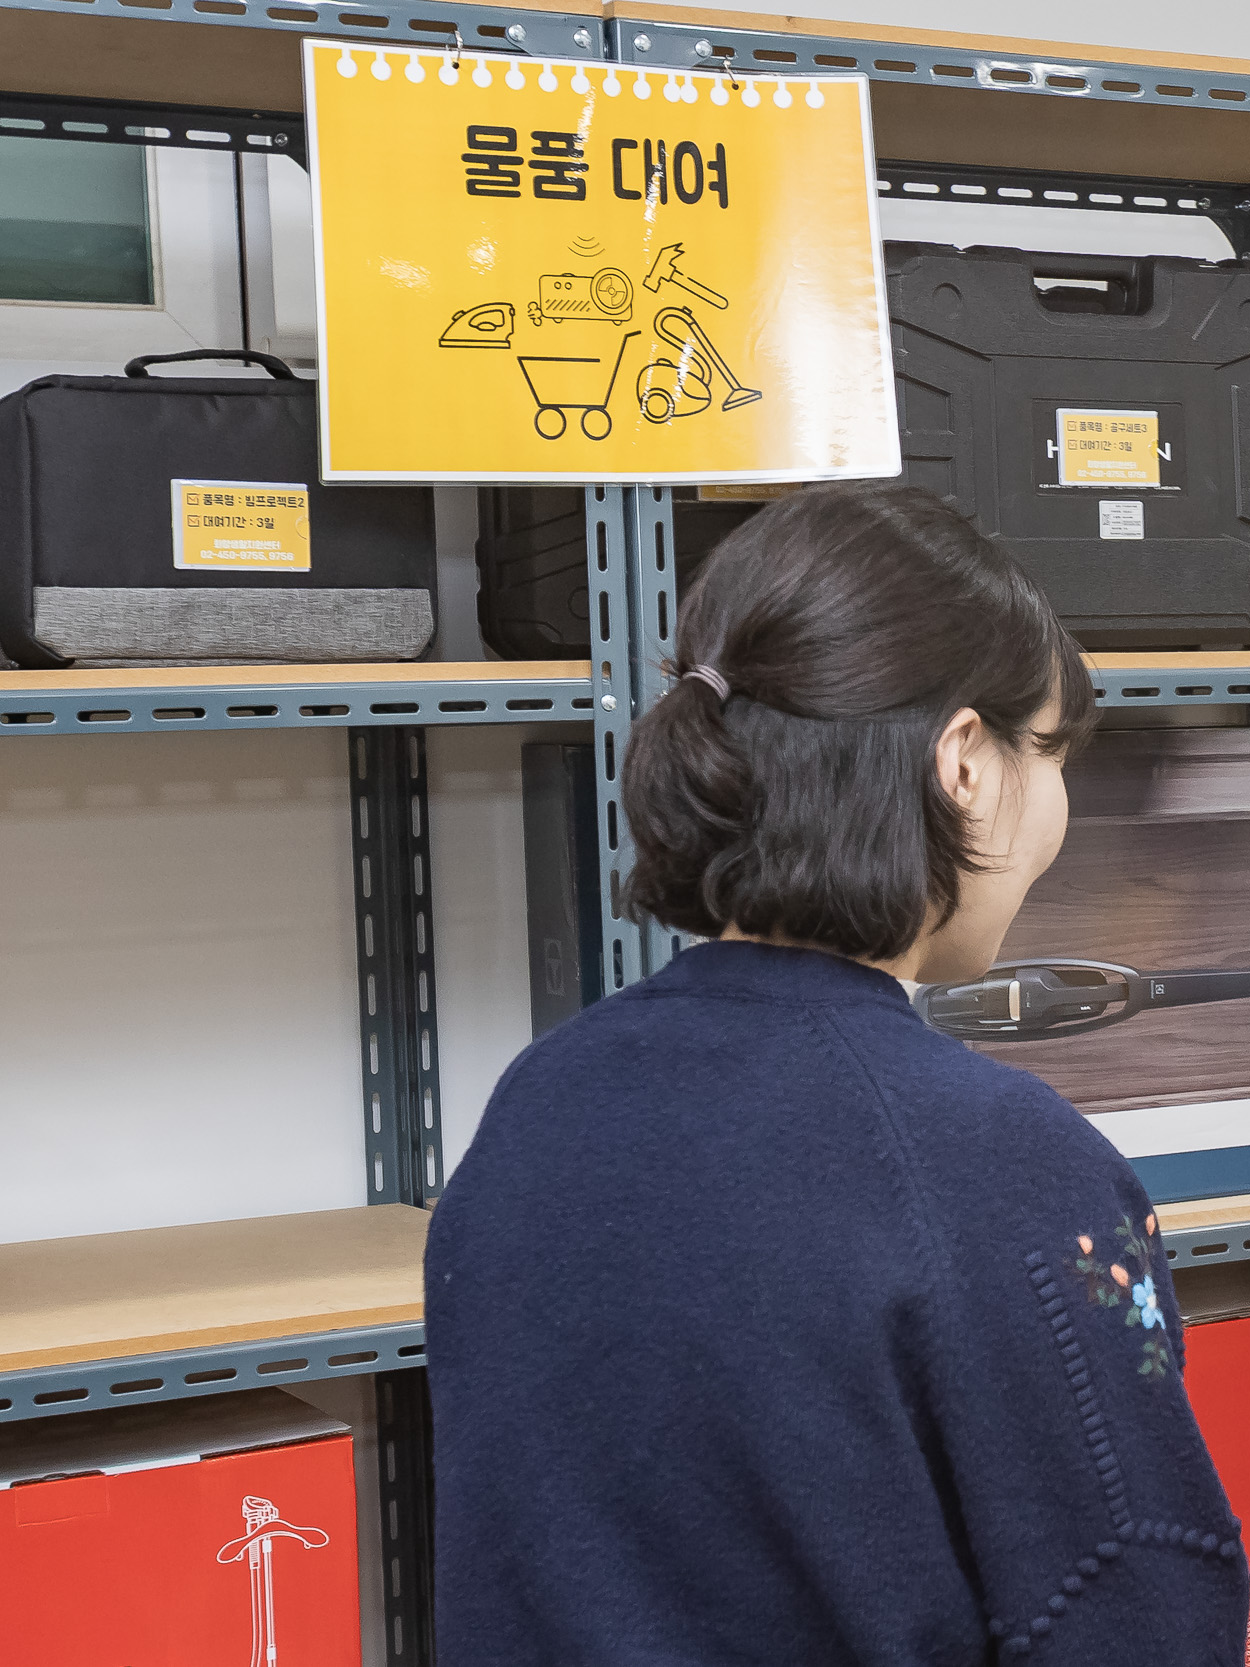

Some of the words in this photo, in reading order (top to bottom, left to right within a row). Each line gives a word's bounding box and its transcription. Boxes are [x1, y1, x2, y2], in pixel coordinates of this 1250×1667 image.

[461, 124, 590, 201] 물품
[612, 138, 729, 209] 대여
[203, 493, 234, 507] 품목명
[245, 495, 305, 508] 빔프로젝트2
[203, 515, 246, 528] 대여기간
[256, 517, 275, 530] 3일
